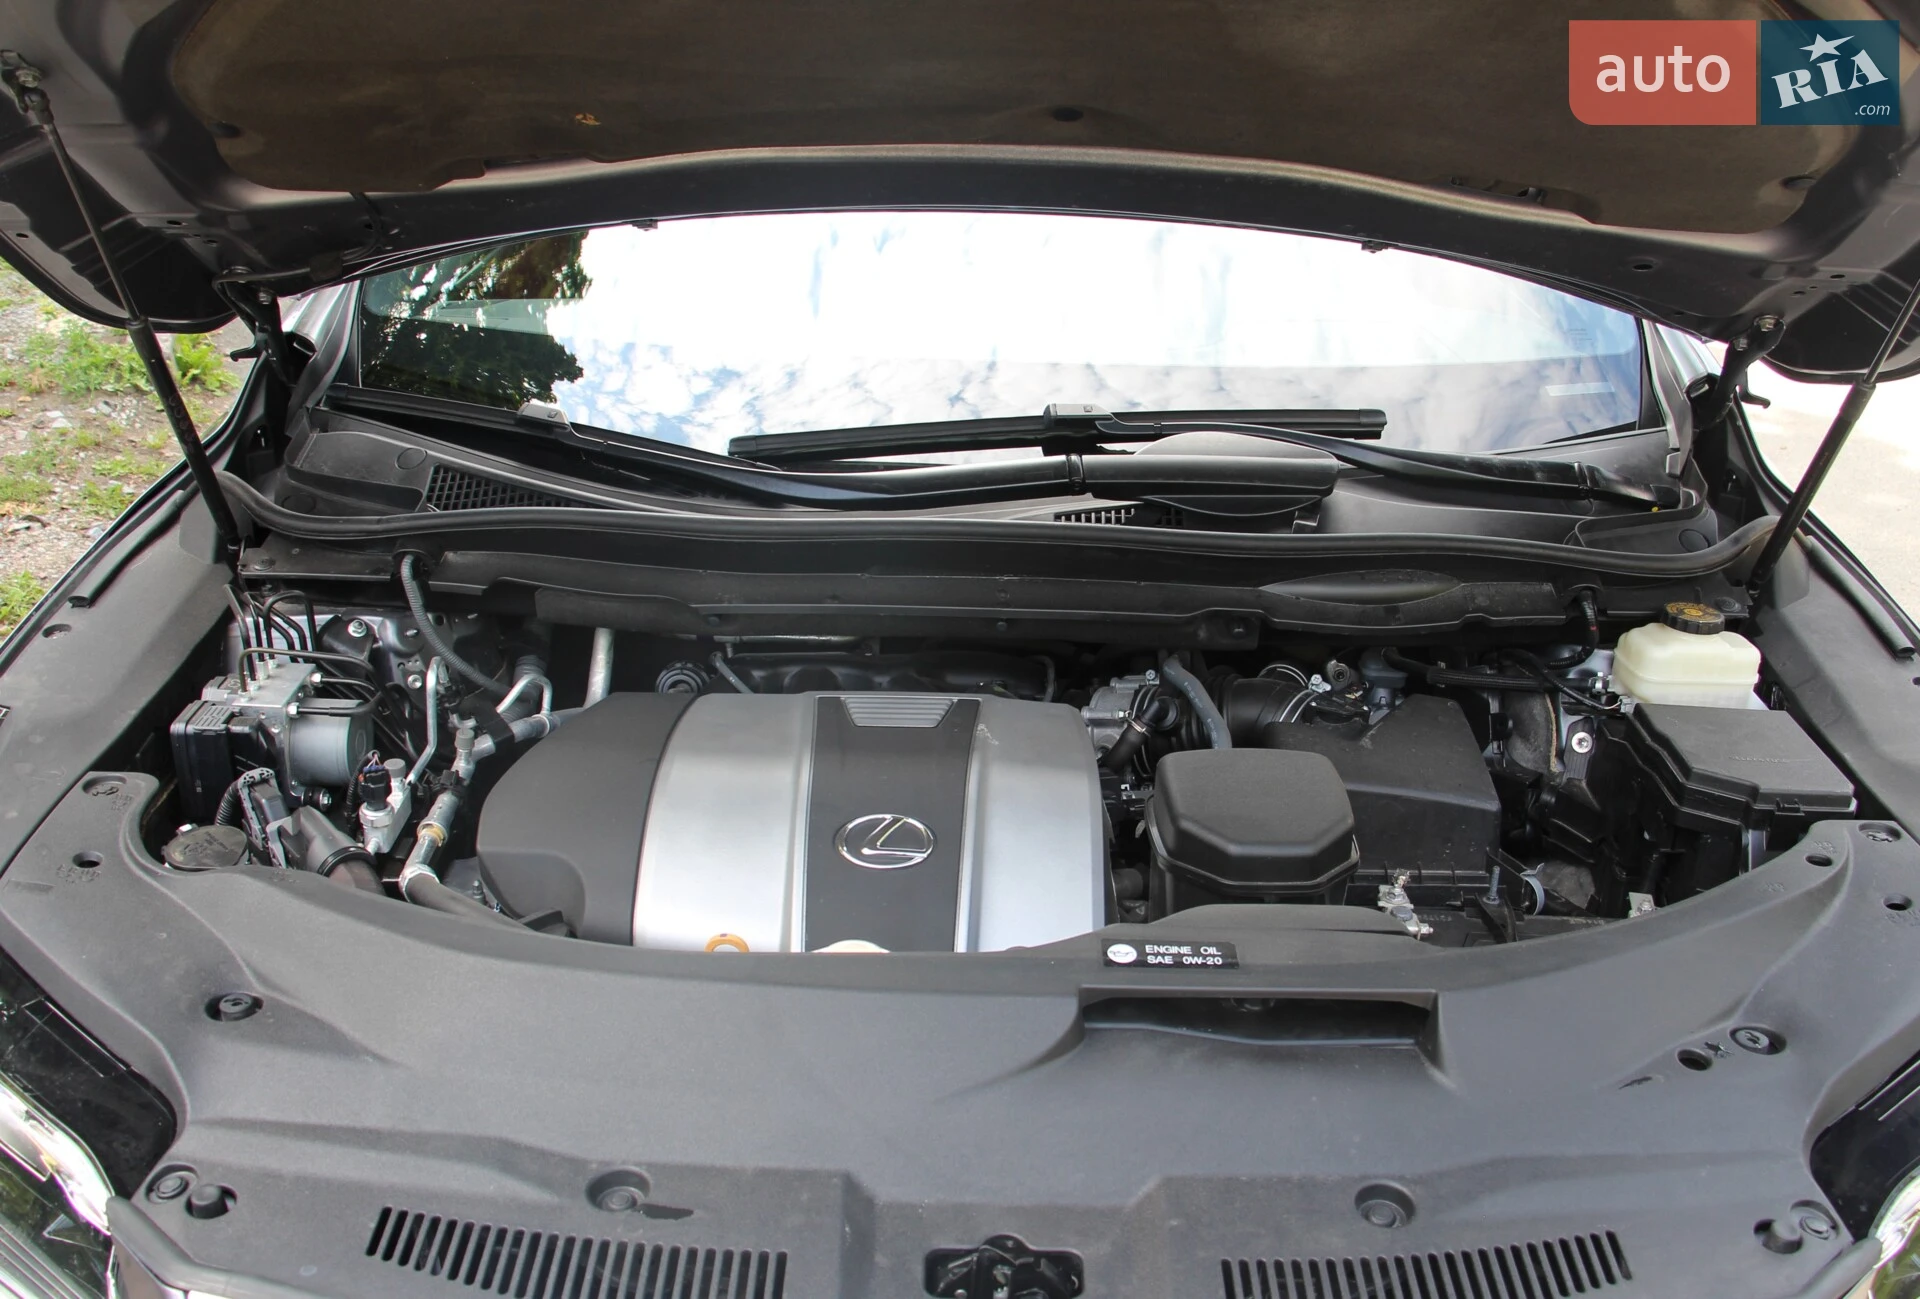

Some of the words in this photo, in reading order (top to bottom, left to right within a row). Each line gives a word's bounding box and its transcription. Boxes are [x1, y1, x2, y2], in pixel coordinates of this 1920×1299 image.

[1145, 944, 1193, 954] ENGINE
[1200, 946, 1222, 955] OIL
[1147, 955, 1174, 965] SAE
[1182, 956, 1223, 966] 0W-20
